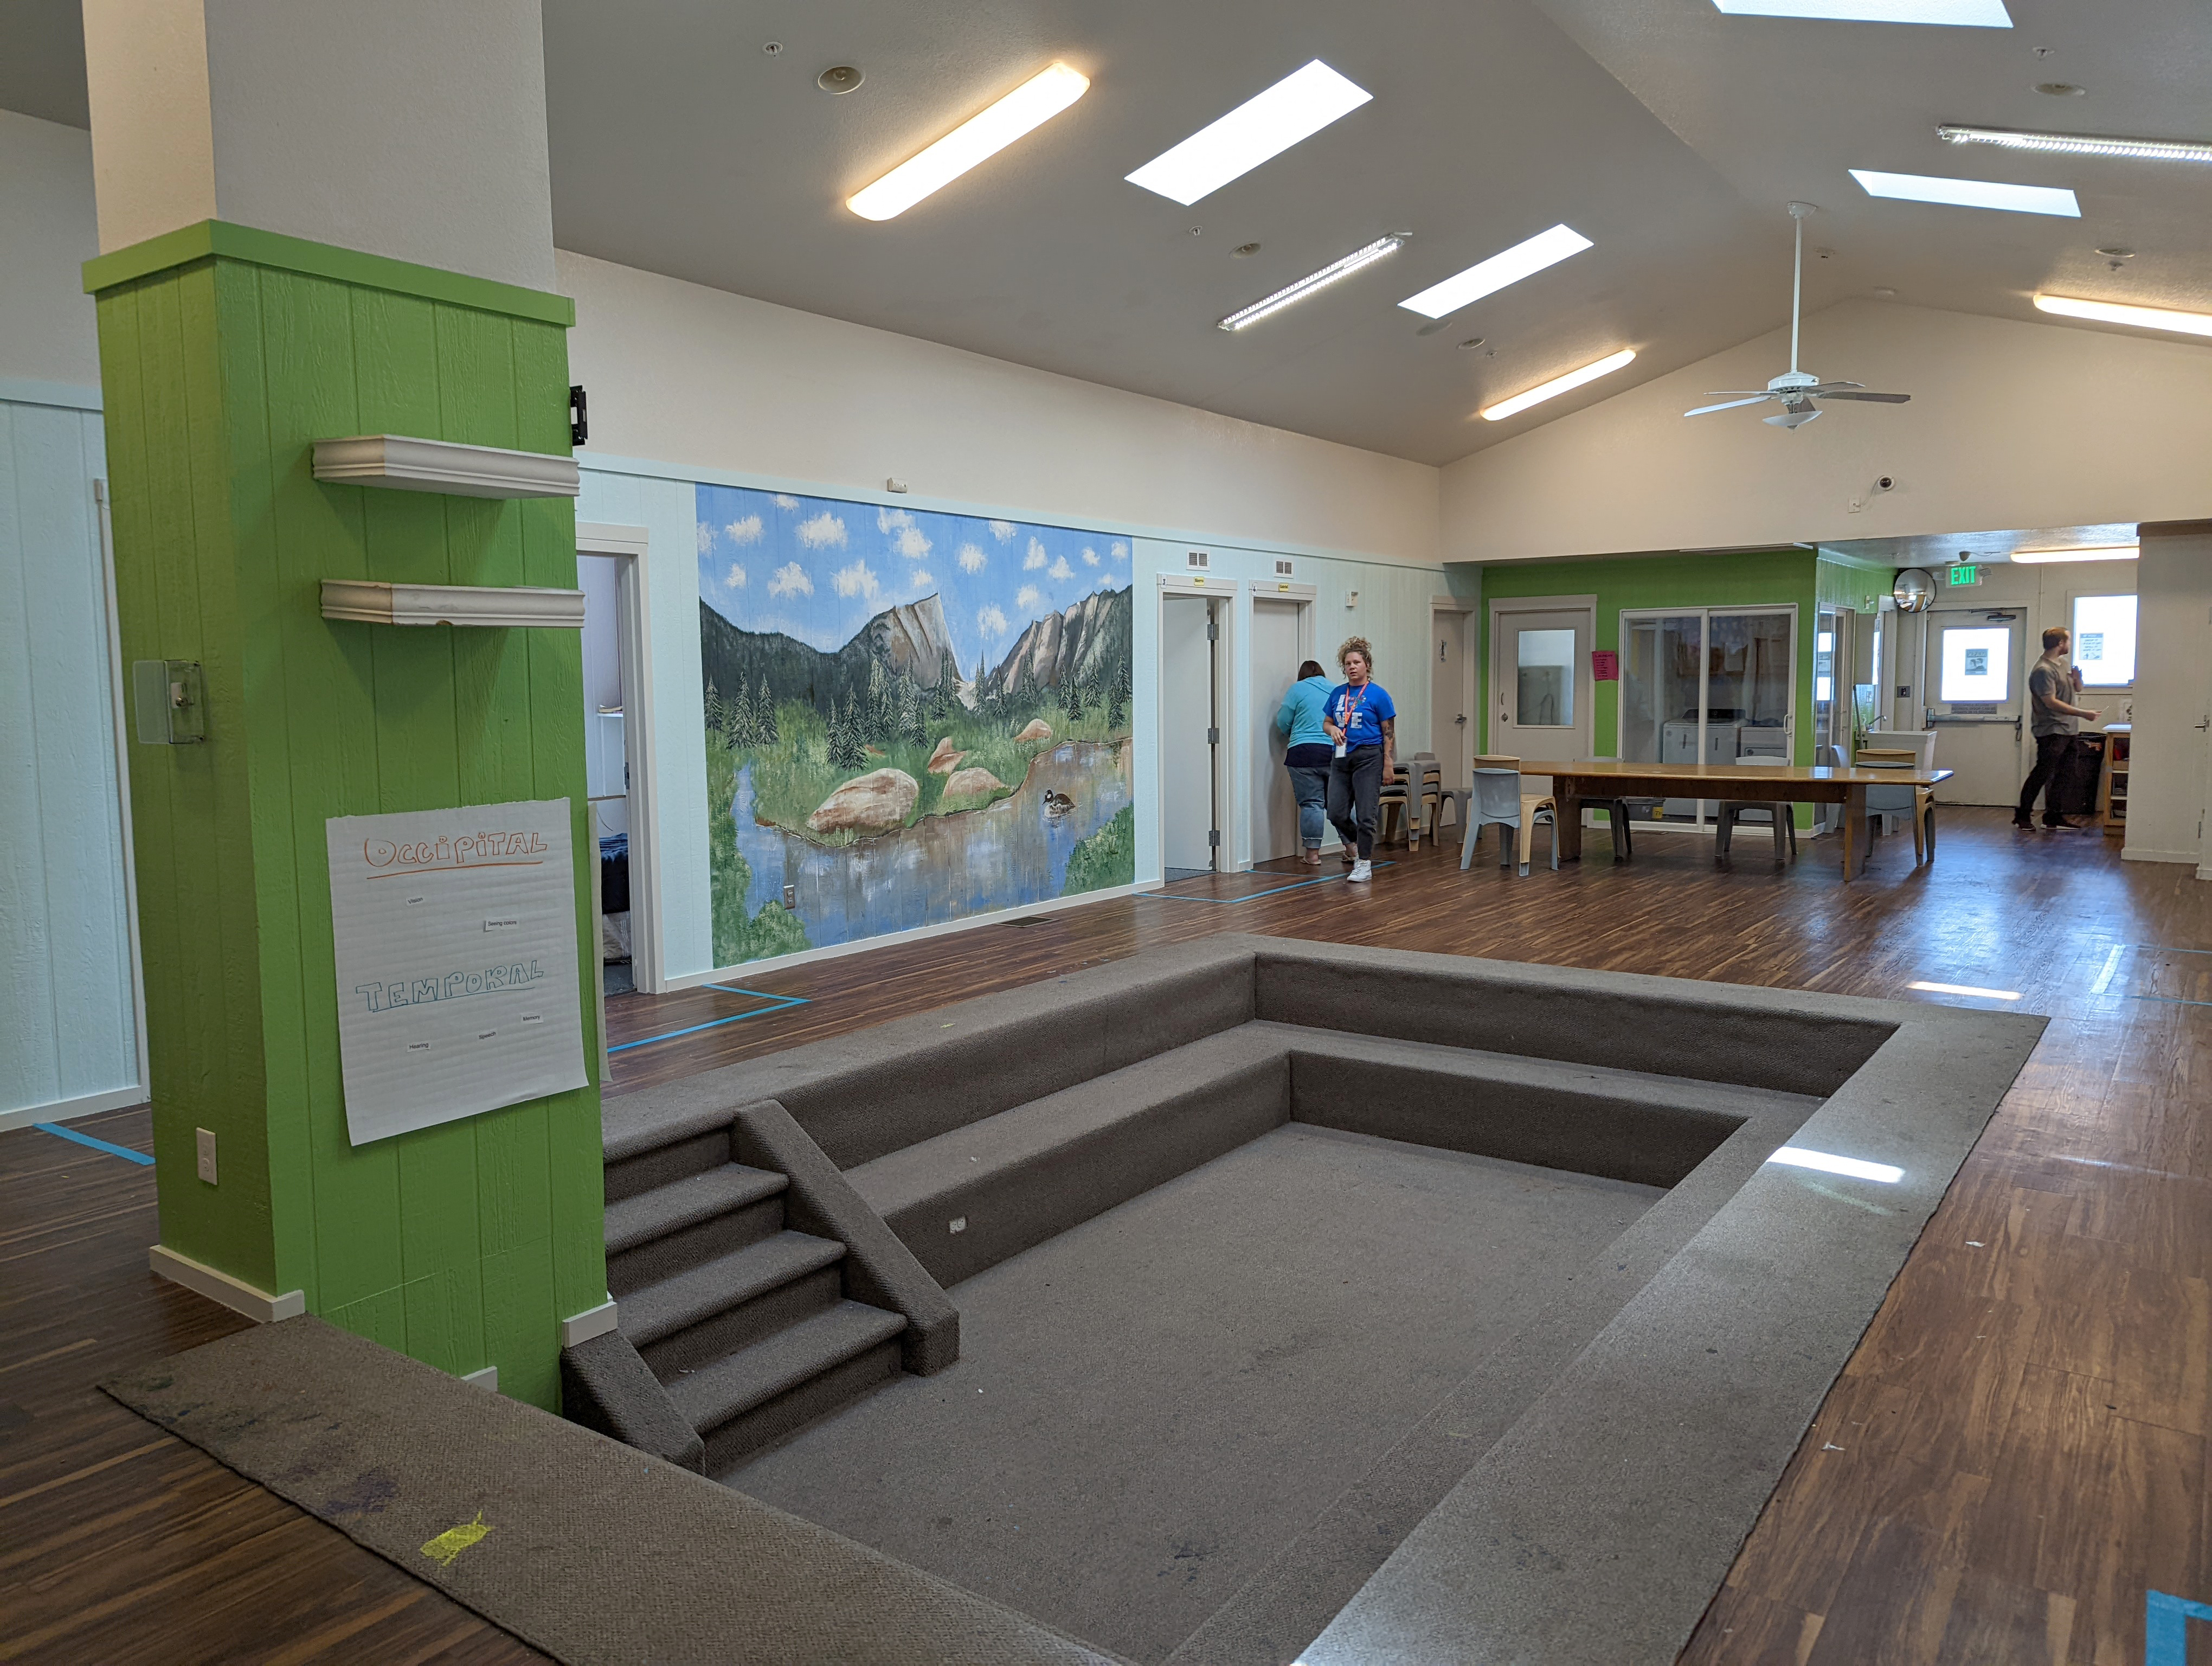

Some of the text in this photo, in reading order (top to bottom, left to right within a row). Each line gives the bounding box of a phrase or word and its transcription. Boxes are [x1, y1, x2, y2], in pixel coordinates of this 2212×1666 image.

[1951, 566, 1976, 585] EXIT
[356, 960, 544, 1011] TEMPORAL
[479, 1031, 497, 1040] Speech
